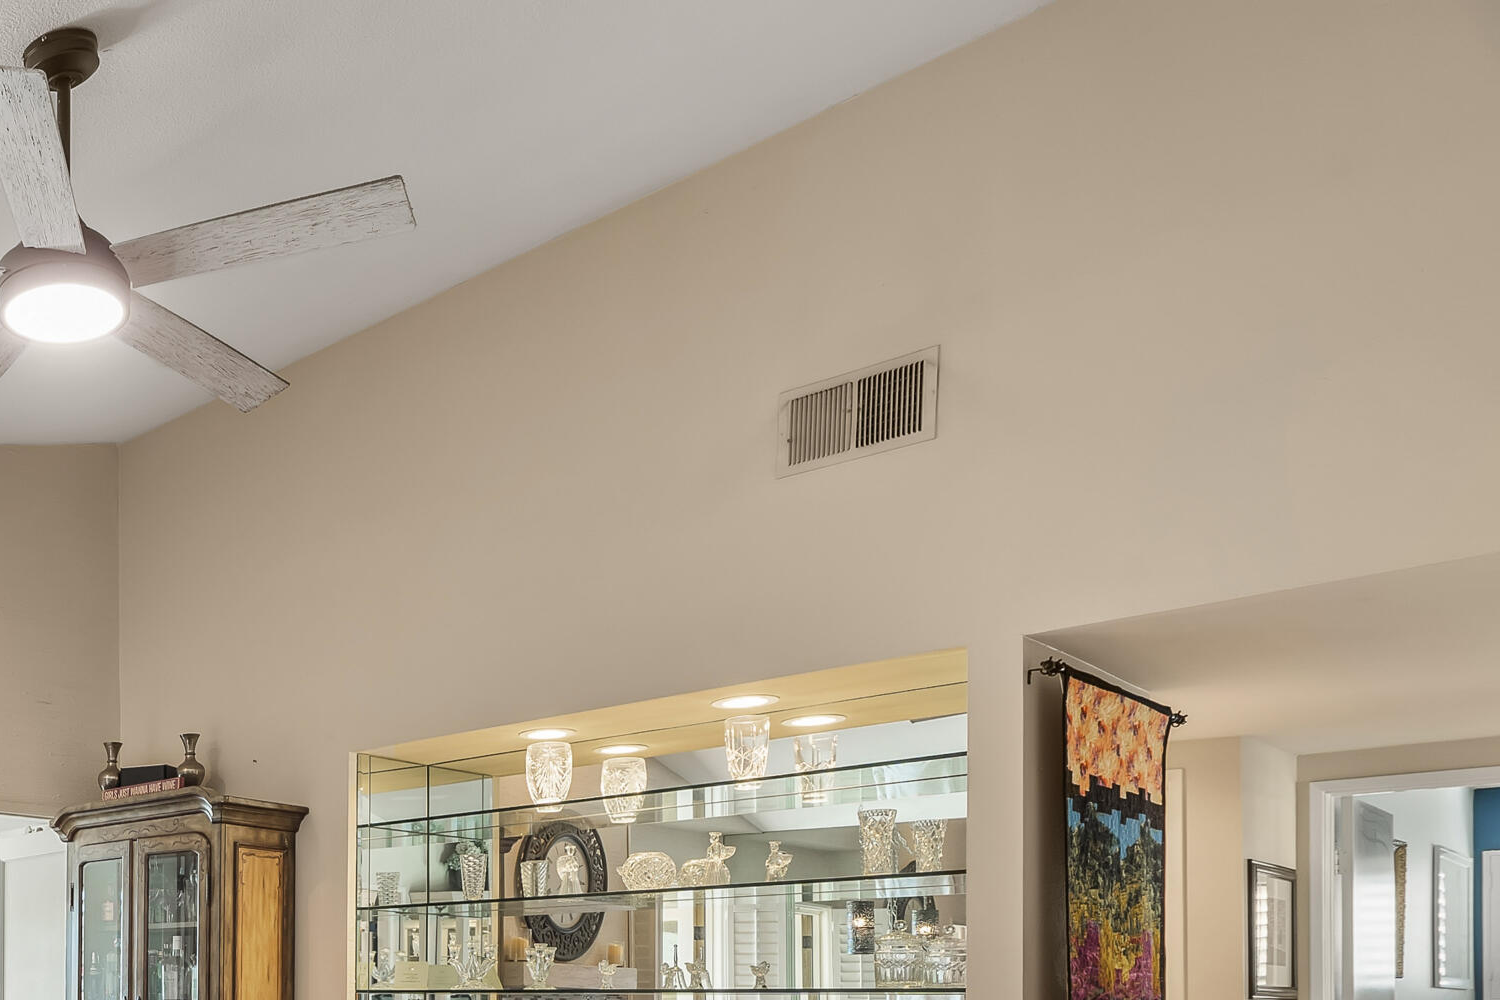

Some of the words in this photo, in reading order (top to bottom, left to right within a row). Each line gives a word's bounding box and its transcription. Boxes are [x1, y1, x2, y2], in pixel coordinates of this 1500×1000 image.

[104, 791, 118, 800] GIRLS
[118, 788, 129, 798] JUST
[130, 785, 148, 796] WANNA
[148, 782, 162, 793] HAVE
[162, 780, 175, 790] WINE
